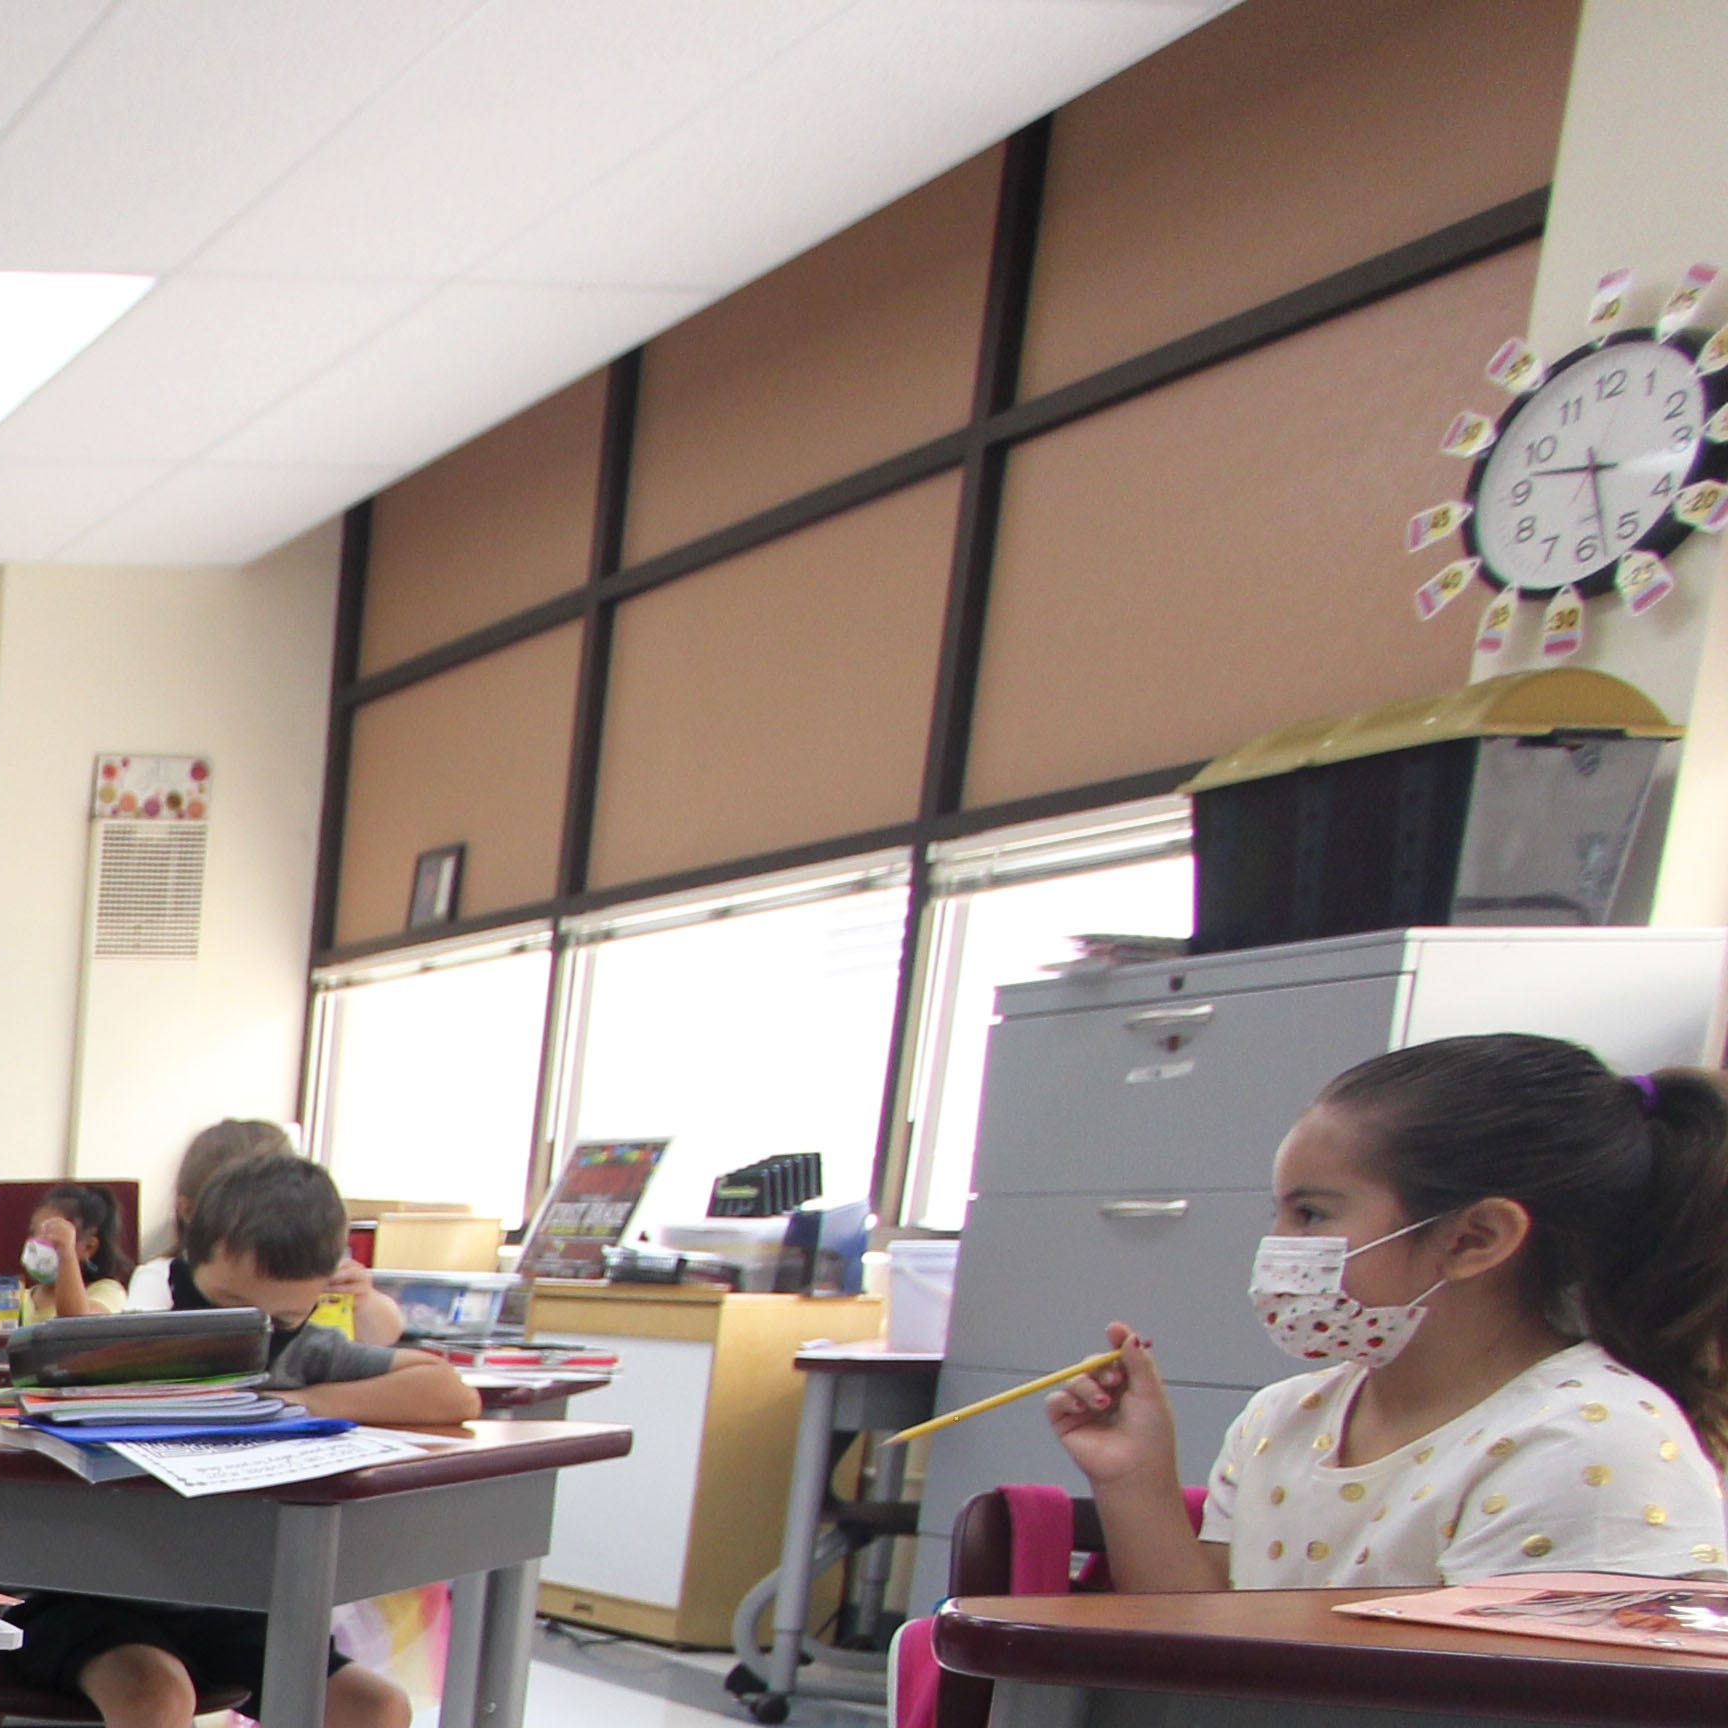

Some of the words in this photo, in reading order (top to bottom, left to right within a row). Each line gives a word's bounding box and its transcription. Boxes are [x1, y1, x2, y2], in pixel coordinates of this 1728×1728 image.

[1595, 369, 1627, 402] 12
[1644, 367, 1656, 397] 1
[1559, 395, 1583, 427] 11
[1663, 390, 1687, 421] 2
[1524, 435, 1557, 467] 10
[1671, 424, 1693, 452] 3
[1510, 478, 1532, 507] 9
[1649, 471, 1673, 497] 4
[1515, 515, 1536, 543] 8
[1615, 510, 1640, 540] 5
[1540, 535, 1560, 564] 7
[1576, 535, 1596, 563] 6
